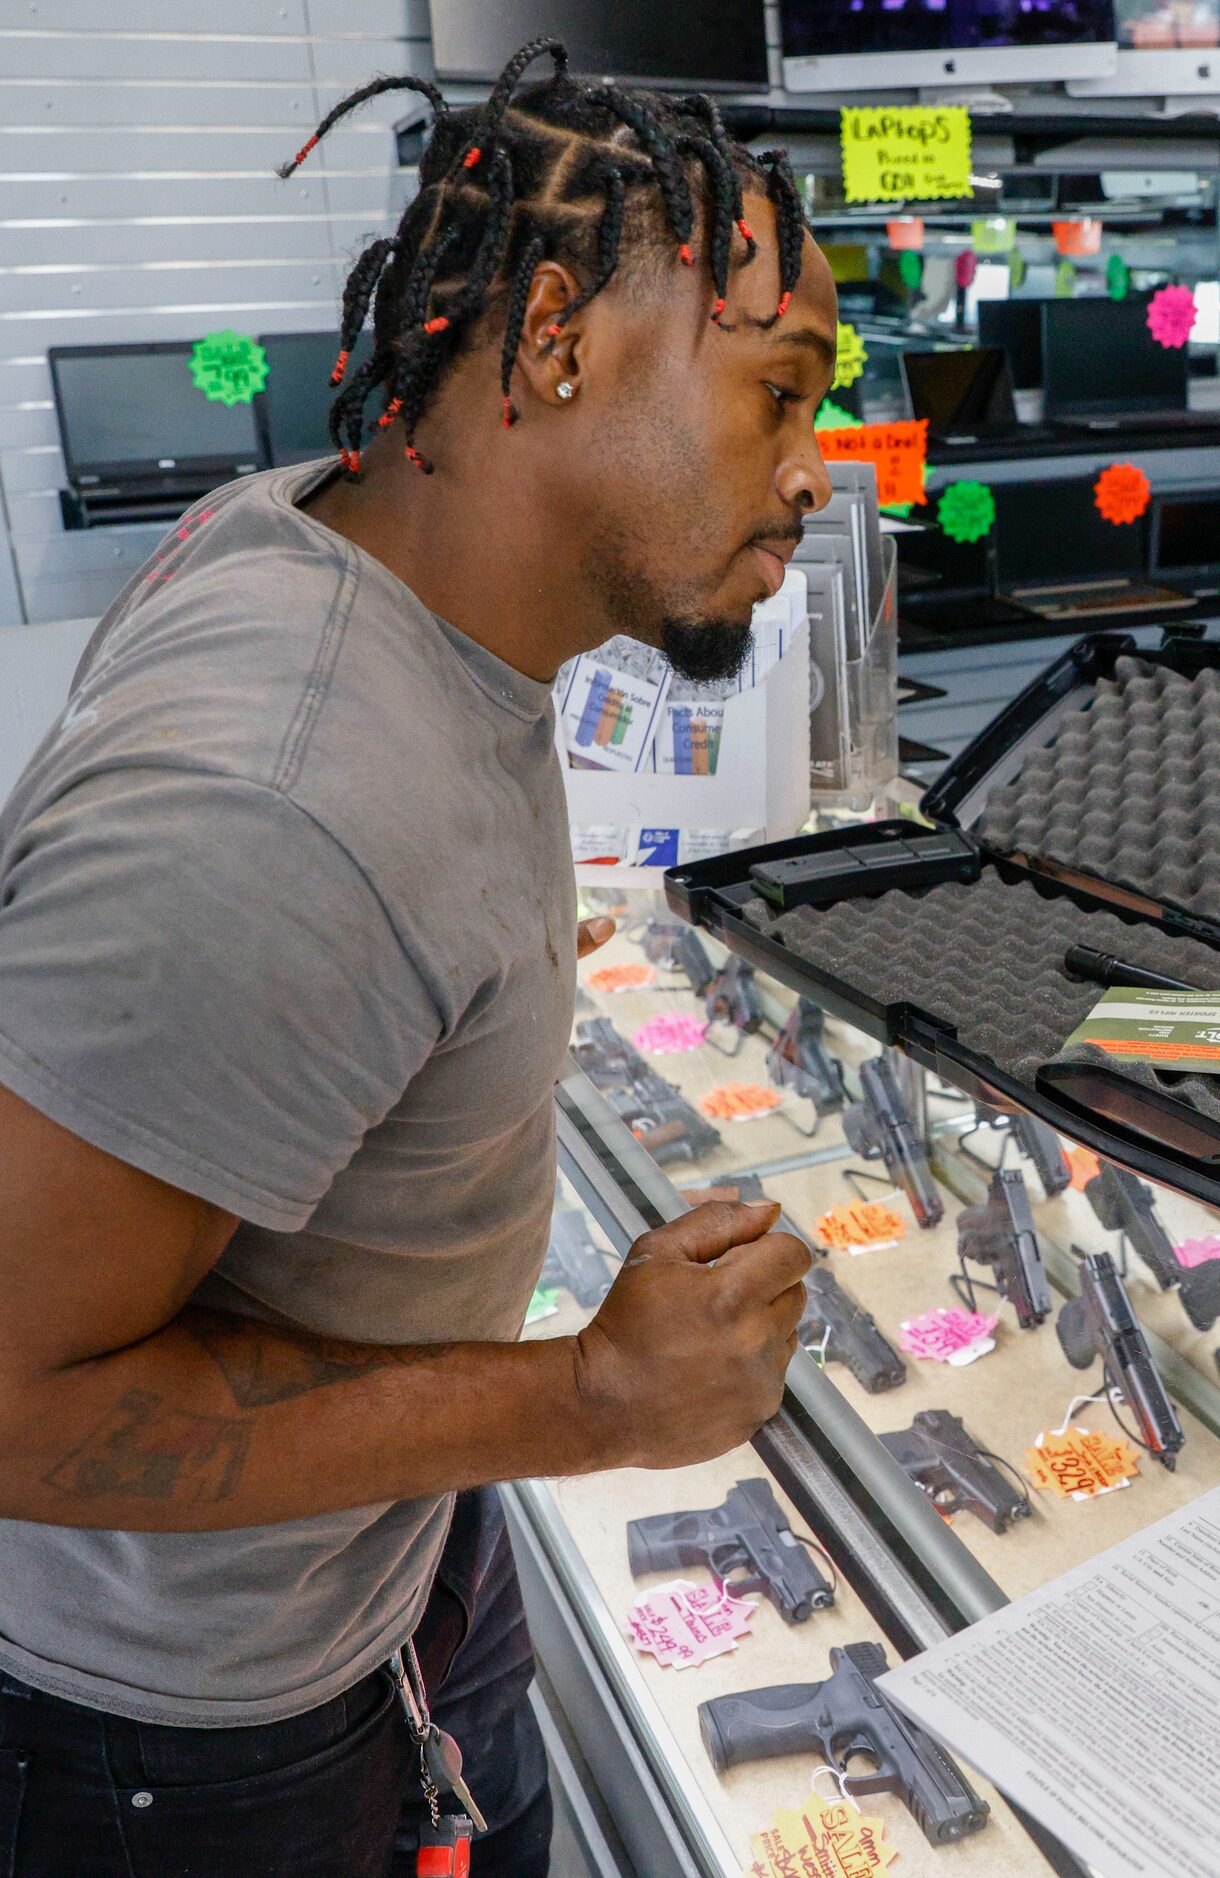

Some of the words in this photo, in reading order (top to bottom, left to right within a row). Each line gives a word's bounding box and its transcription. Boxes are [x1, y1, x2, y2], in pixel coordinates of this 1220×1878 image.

[629, 691, 650, 708] Sobre
[667, 706, 693, 717] Facts
[1080, 1436, 1125, 1478] SALE
[685, 1586, 732, 1637] SALE
[759, 1831, 776, 1859] PRICE
[770, 1827, 784, 1851] SALE
[819, 1806, 874, 1878] SALE
[860, 1829, 880, 1868] 9mm
